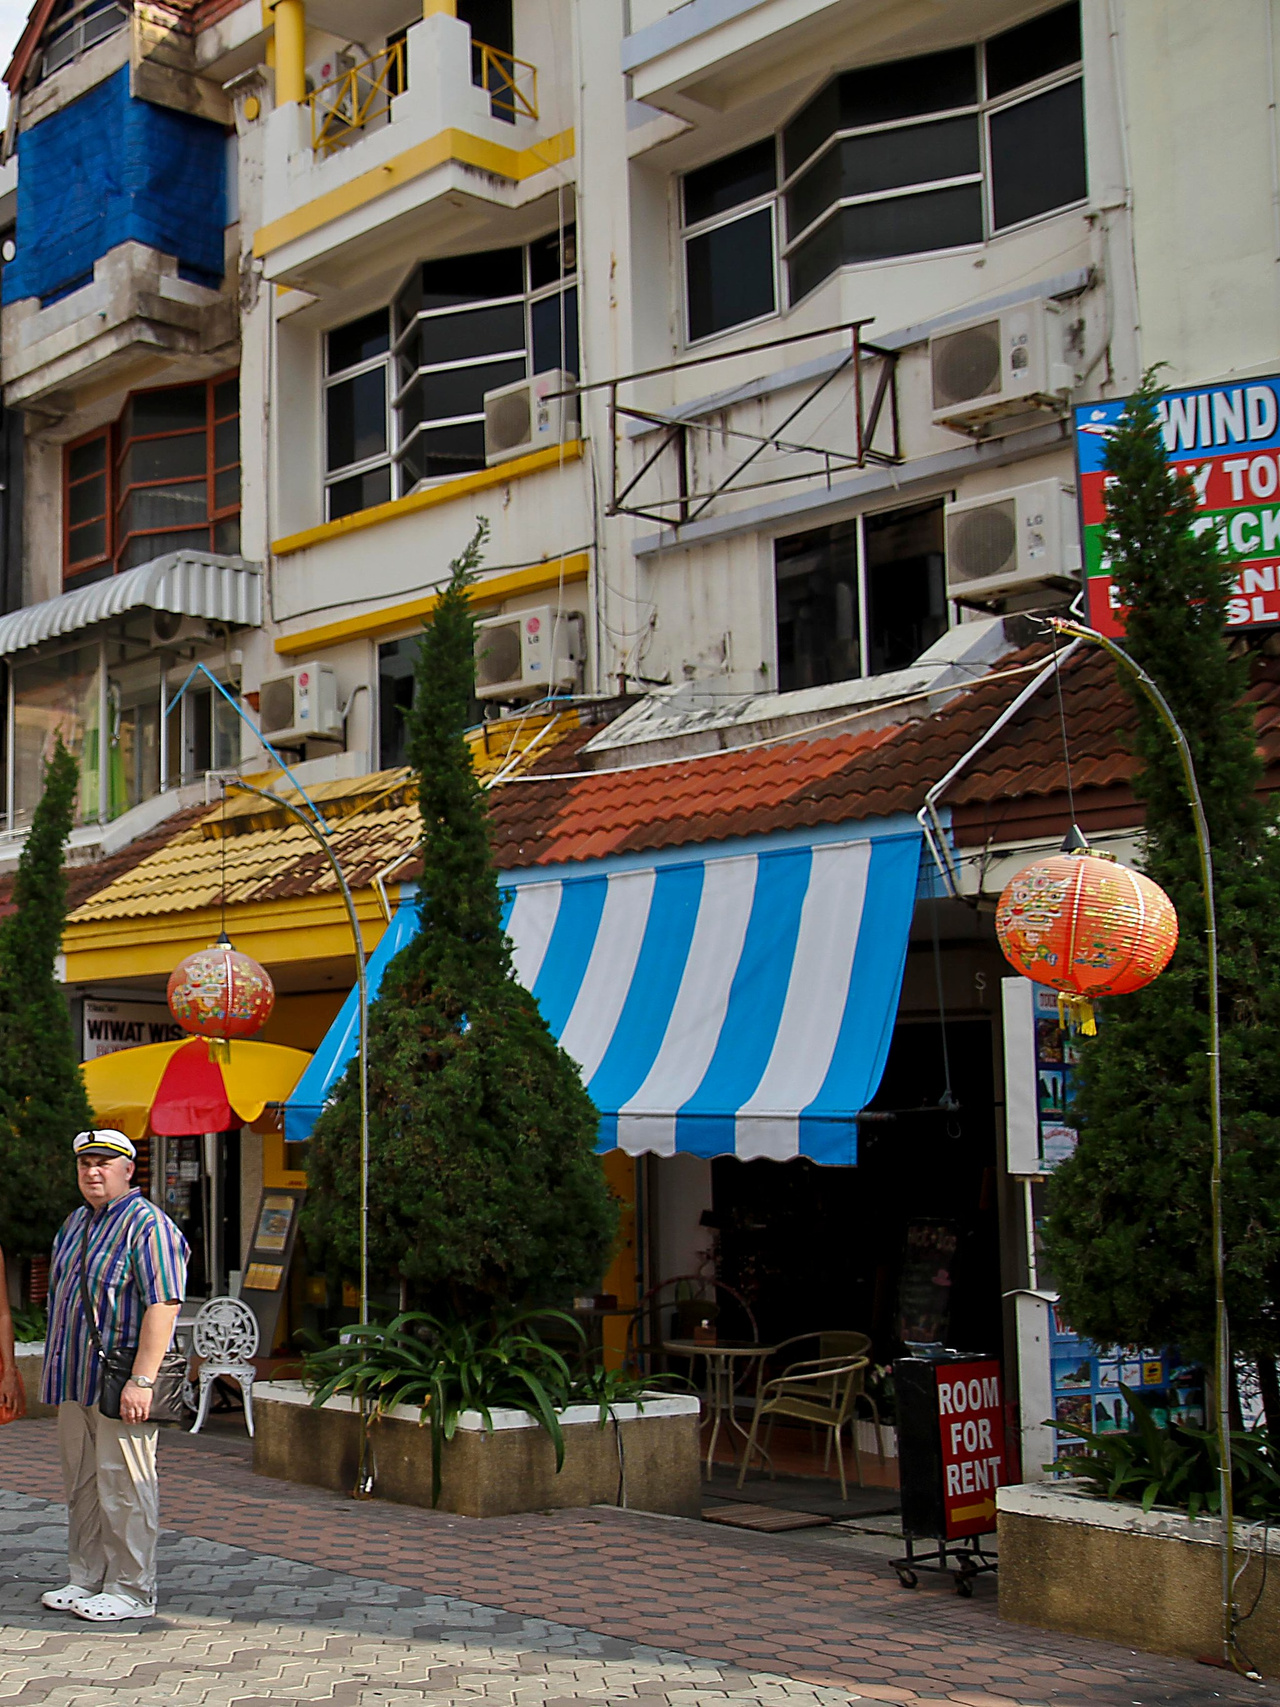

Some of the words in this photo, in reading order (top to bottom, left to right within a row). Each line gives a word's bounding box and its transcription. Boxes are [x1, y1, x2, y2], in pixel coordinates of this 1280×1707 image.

[1158, 386, 1278, 452] WIND
[1223, 455, 1280, 501] TO
[87, 1020, 145, 1042] WIWAT
[938, 1376, 999, 1415] ROOM
[950, 1418, 993, 1455] FOR
[946, 1455, 1002, 1497] RENT
